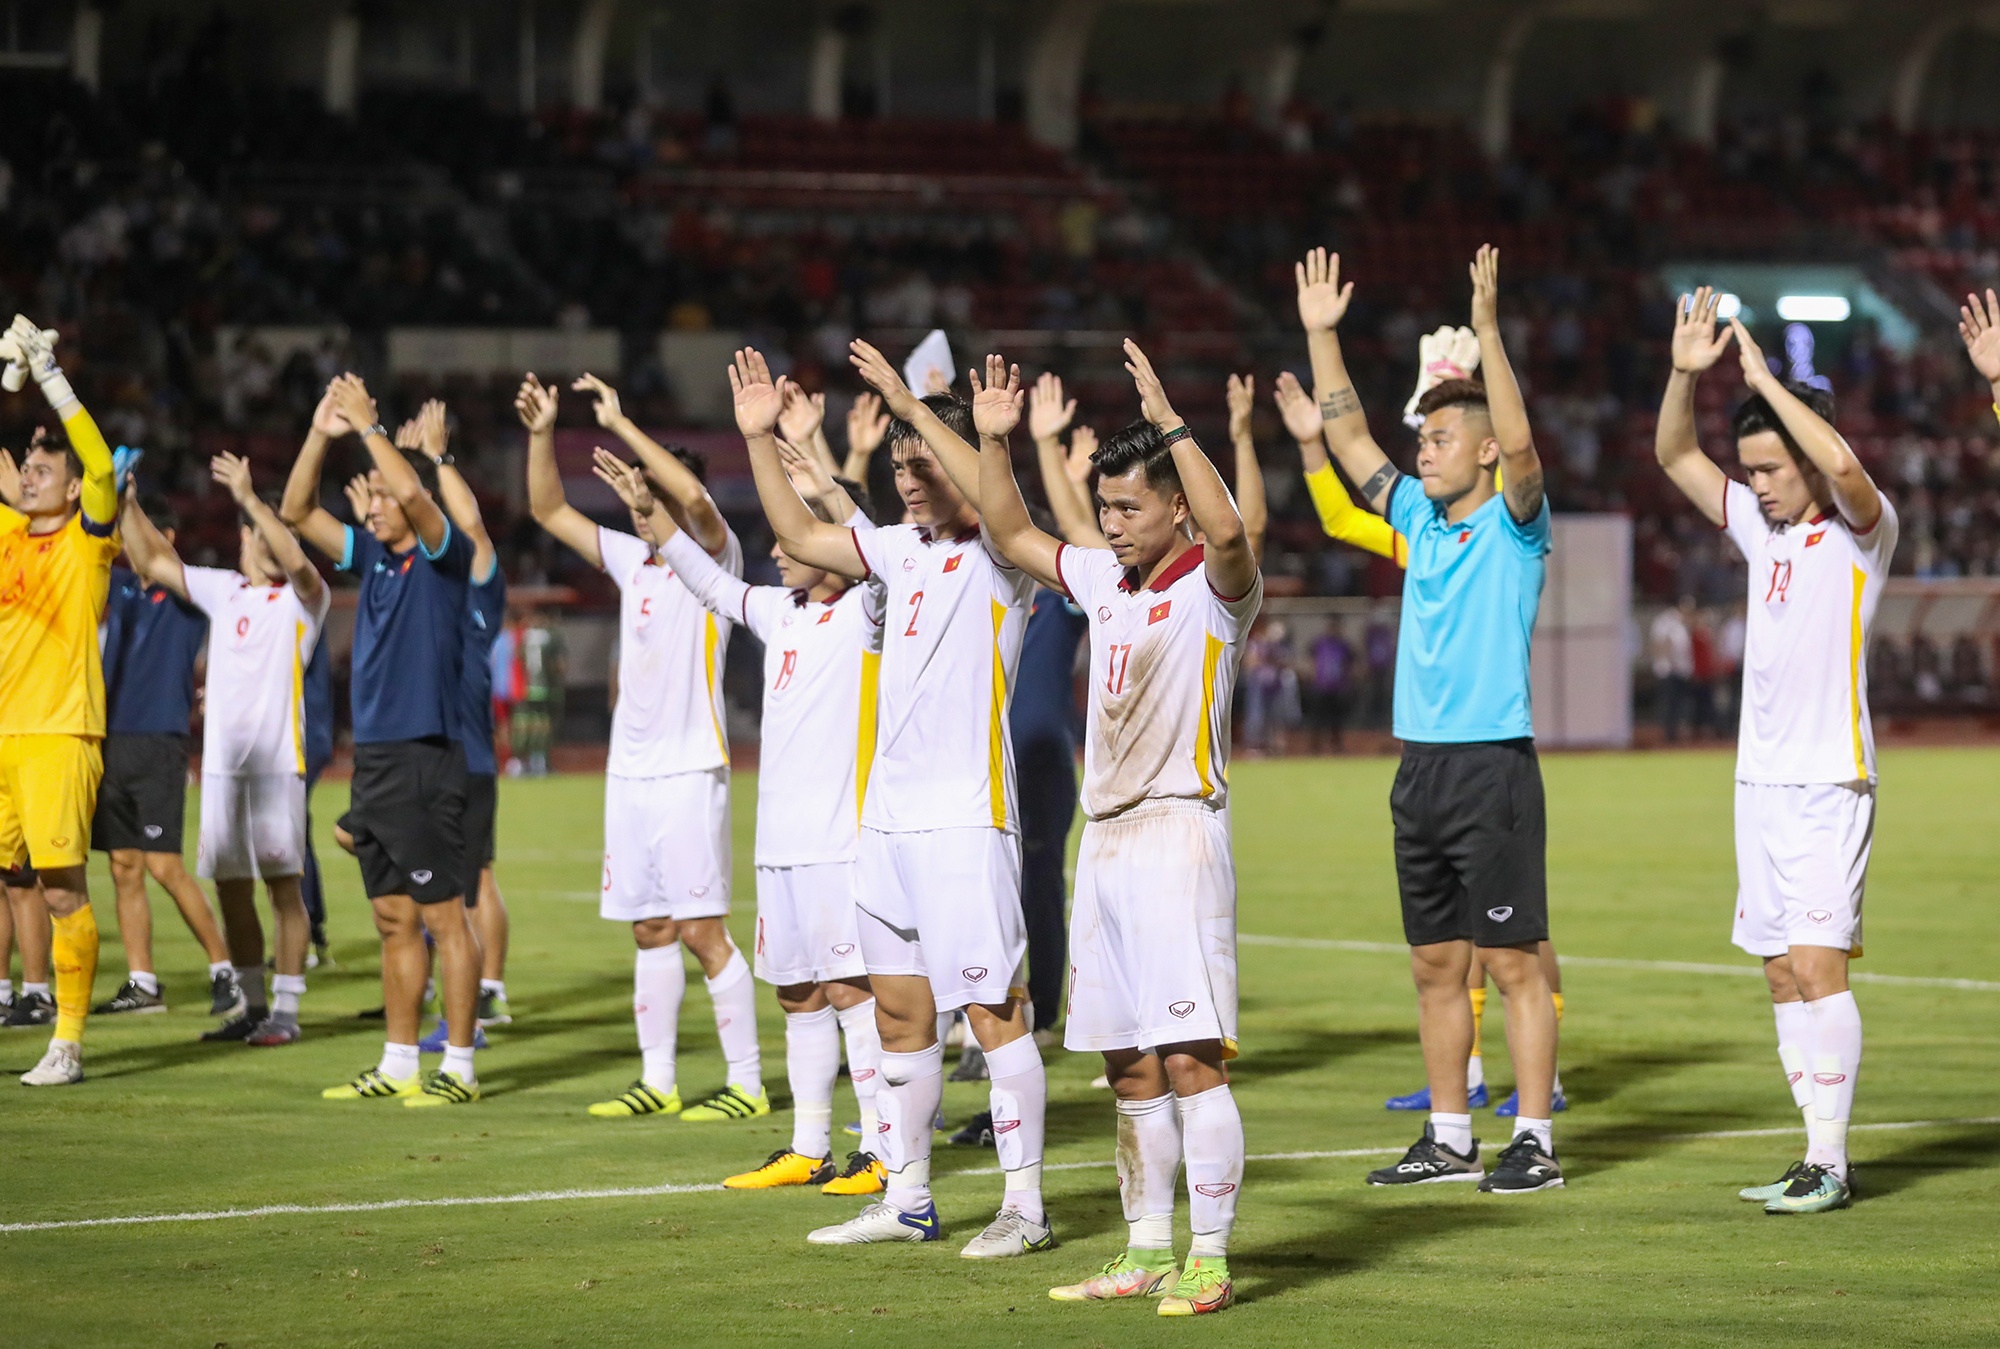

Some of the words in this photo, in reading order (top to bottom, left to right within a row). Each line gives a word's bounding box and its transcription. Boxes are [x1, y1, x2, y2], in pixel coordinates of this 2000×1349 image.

[1766, 559, 1792, 602] 14
[904, 591, 923, 637] 2
[773, 650, 797, 690] 19
[1107, 643, 1132, 695] 17
